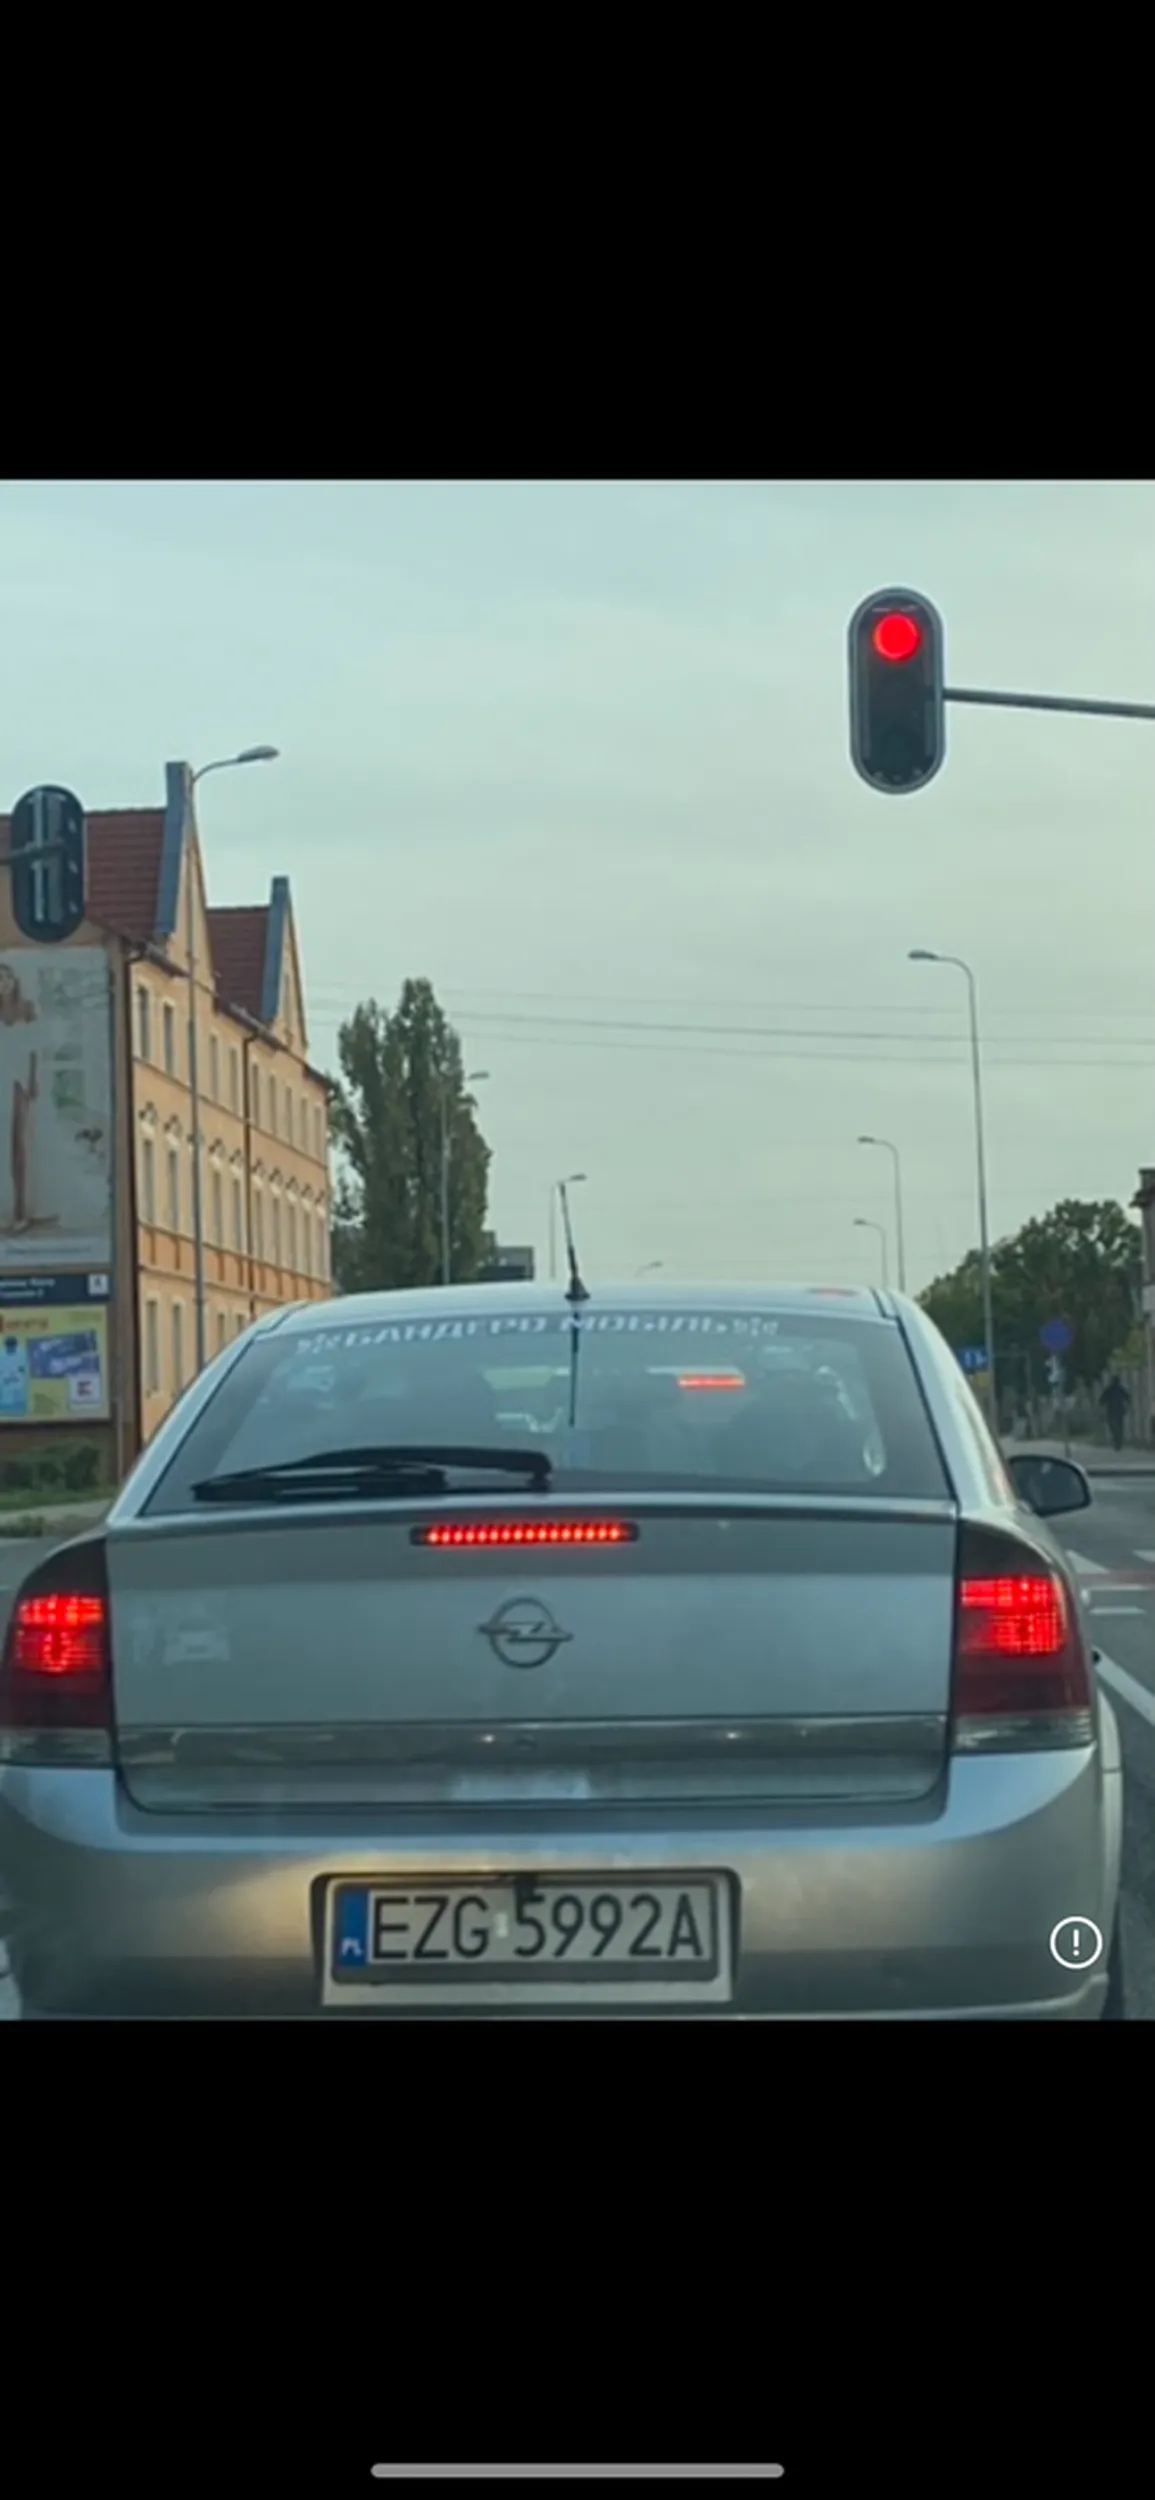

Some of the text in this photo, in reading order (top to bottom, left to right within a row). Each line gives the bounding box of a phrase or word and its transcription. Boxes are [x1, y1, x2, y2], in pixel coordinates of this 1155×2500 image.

[342, 1938, 365, 1956] PL
[373, 1893, 703, 1959] EZG 5992A
